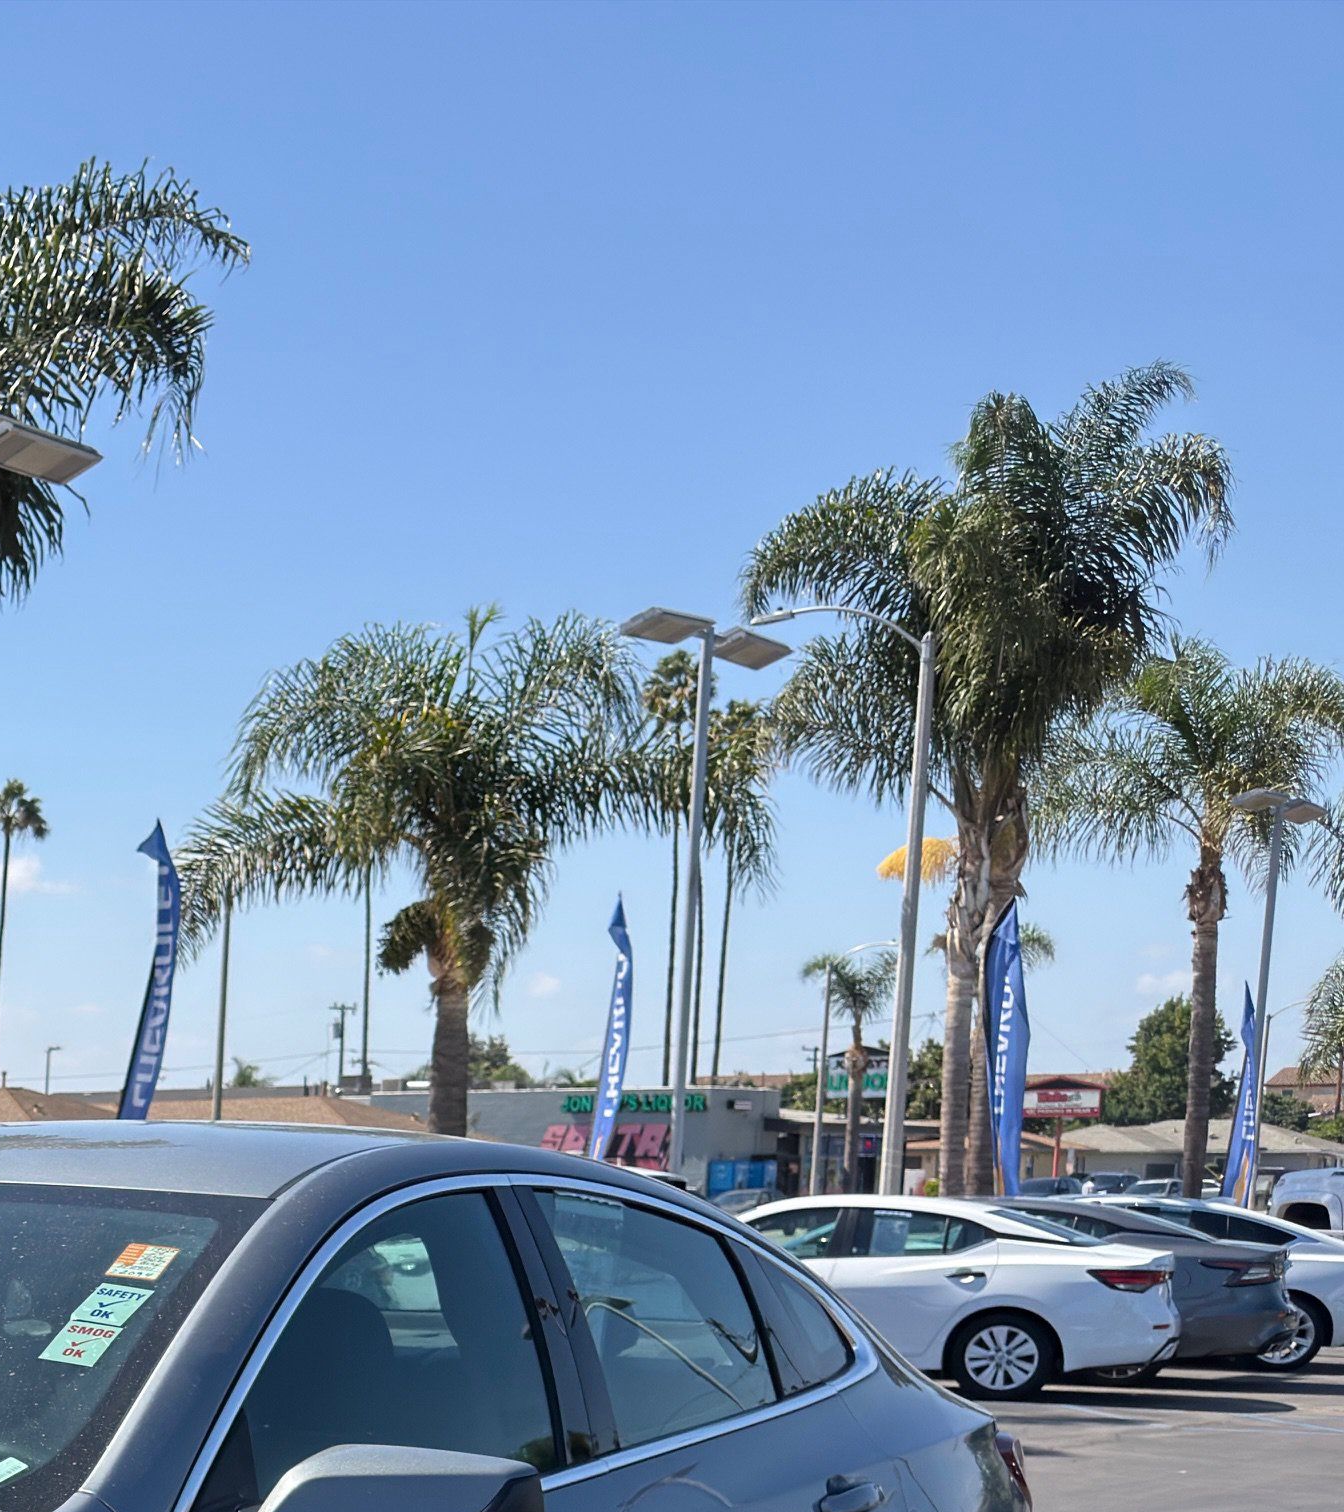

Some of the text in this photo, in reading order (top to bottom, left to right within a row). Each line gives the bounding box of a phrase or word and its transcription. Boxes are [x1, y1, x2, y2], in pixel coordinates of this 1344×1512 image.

[641, 1093, 707, 1112] LIQOR
[96, 1287, 147, 1302] SAFETY
[89, 1309, 114, 1320] OK
[67, 1324, 115, 1339] SMOG
[62, 1347, 86, 1359] OK
